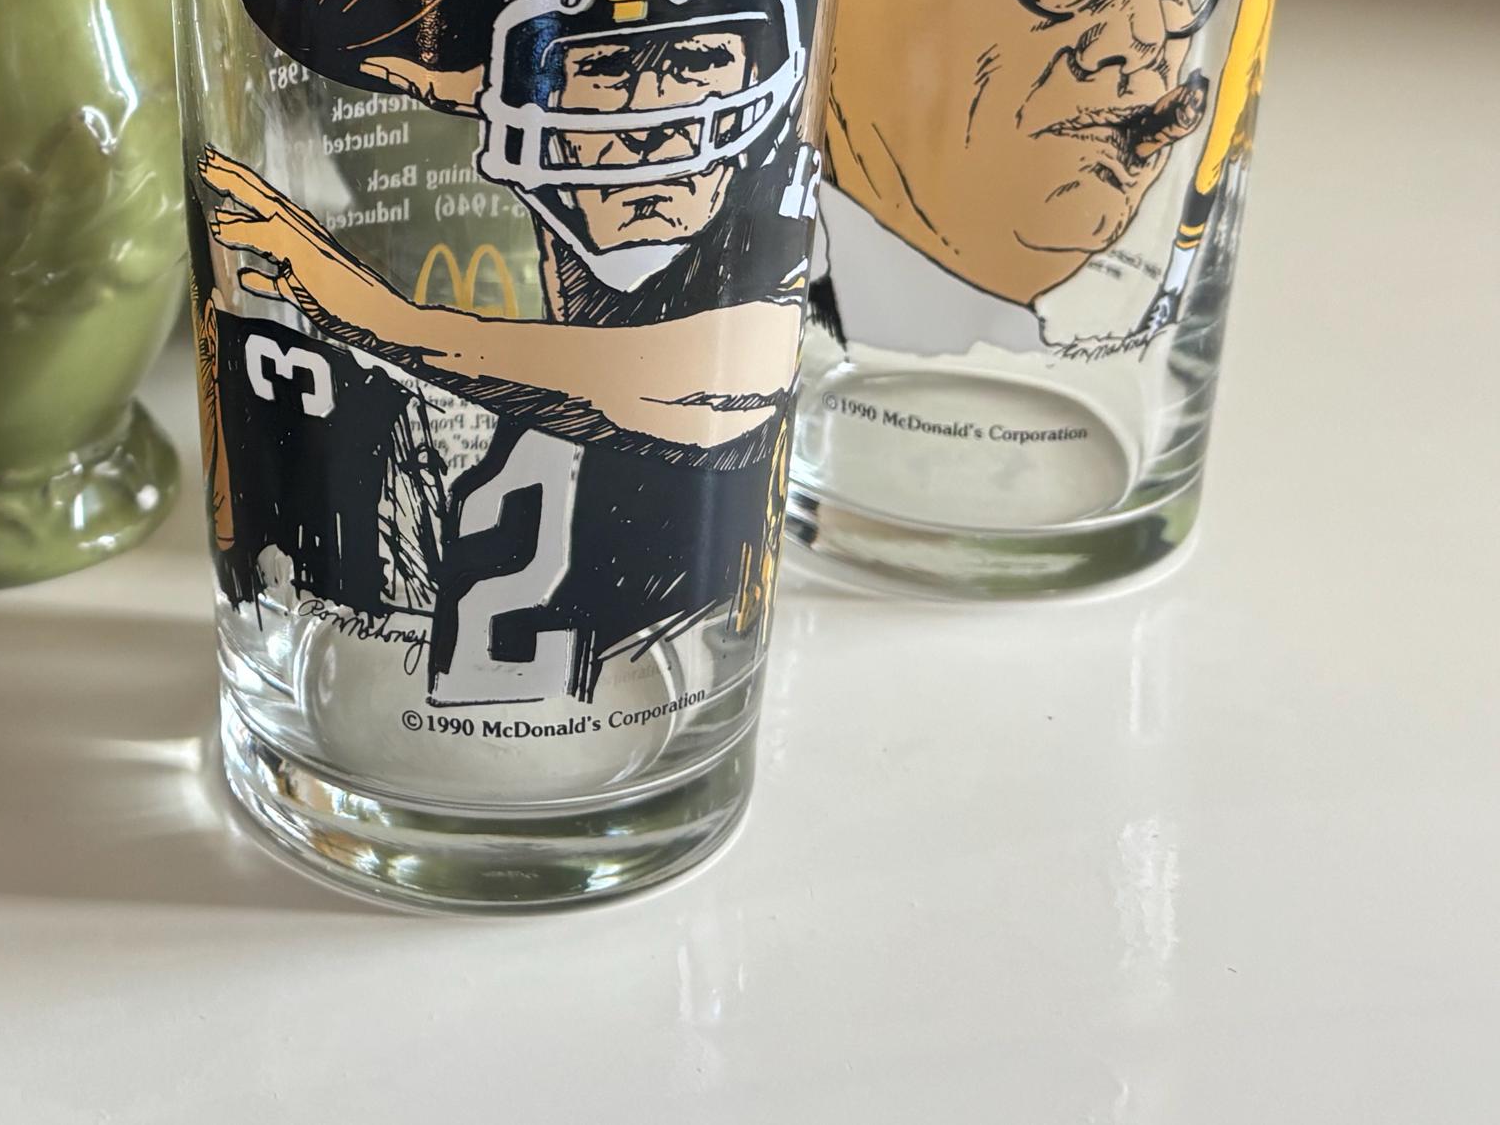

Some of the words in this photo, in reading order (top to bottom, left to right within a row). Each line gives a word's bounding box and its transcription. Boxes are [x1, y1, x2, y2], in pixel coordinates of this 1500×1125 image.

[882, 409, 983, 440] McDonald's
[988, 426, 1089, 445] Corporation
[481, 715, 602, 739] McDonald's
[607, 688, 707, 730] Corporation
